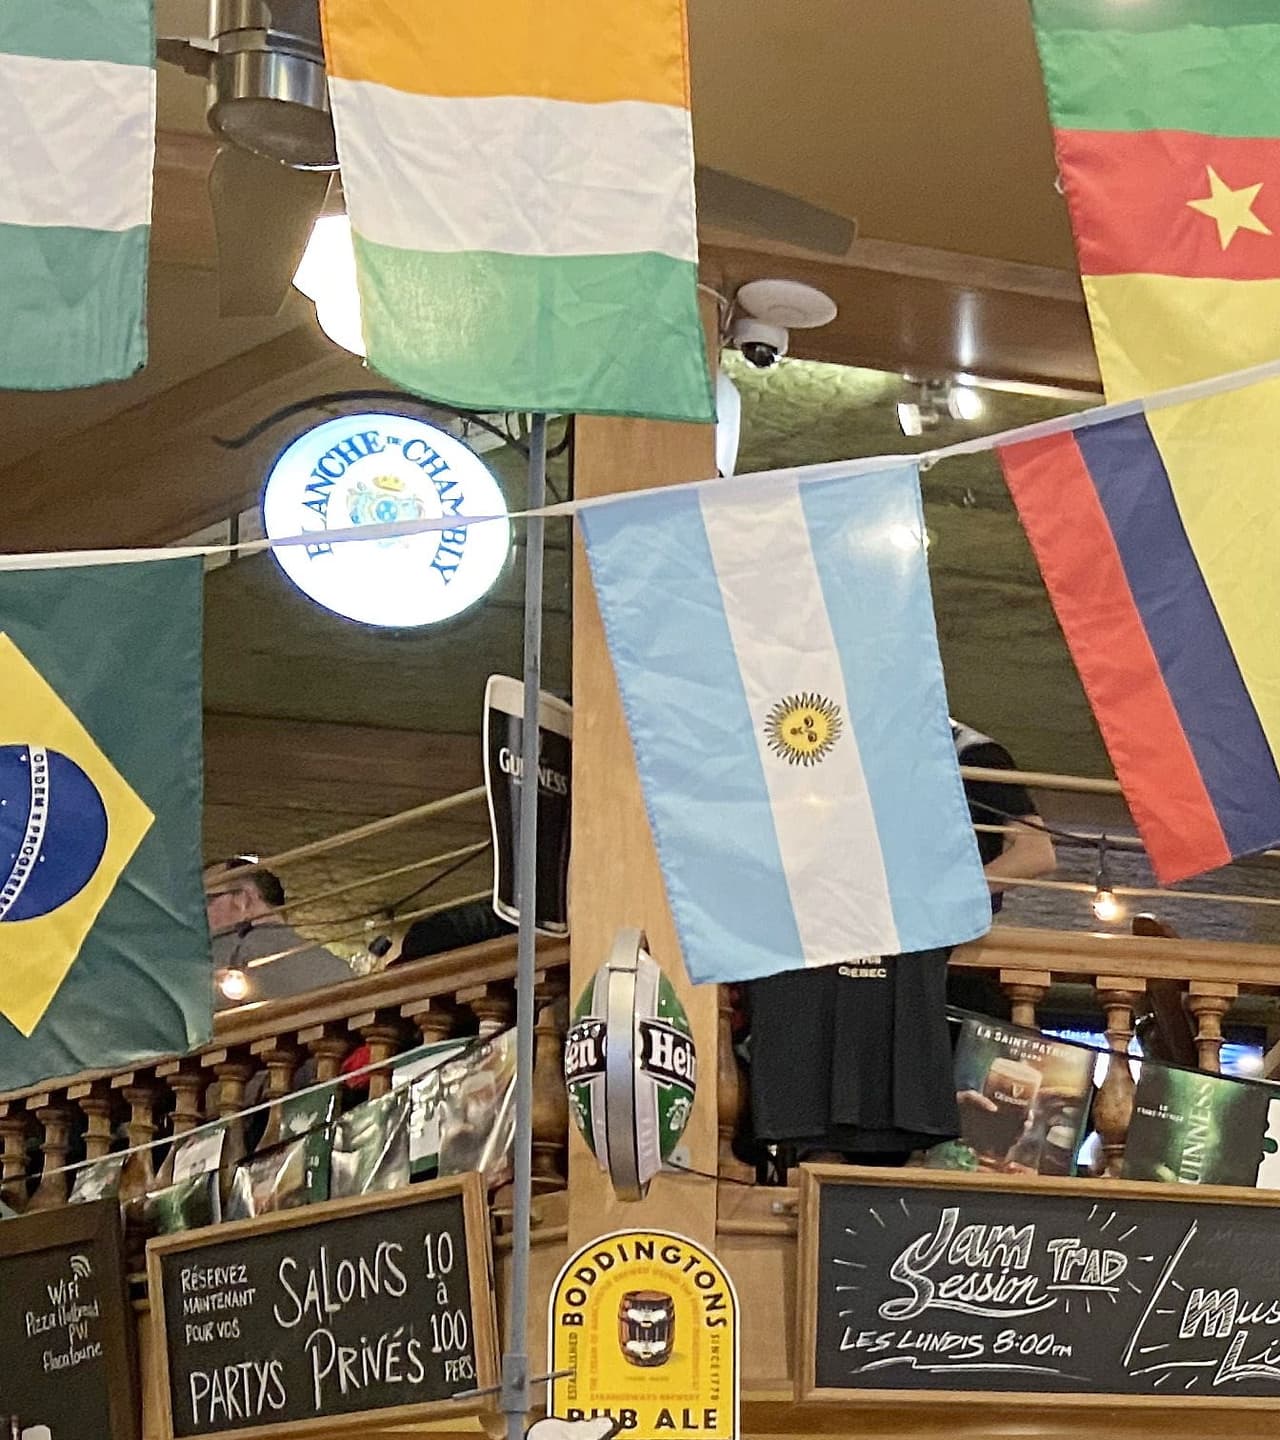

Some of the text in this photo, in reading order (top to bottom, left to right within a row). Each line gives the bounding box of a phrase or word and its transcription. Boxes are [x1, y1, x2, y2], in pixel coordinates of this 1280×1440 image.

[499, 747, 568, 796] GUNESS
[976, 1025, 992, 1040] LA
[423, 1230, 454, 1280] 10
[905, 1206, 1036, 1273] Jam
[182, 1288, 257, 1317] MAINTENANT
[272, 1240, 408, 1329] SALONS
[561, 1239, 728, 1329] BODDINGTONS
[878, 1235, 1050, 1321] Session
[185, 1316, 241, 1347] POUR VOS
[429, 1308, 469, 1355] 100
[839, 1326, 897, 1353] LES
[896, 1329, 985, 1359] LUNDIS
[189, 1359, 287, 1426] PARTYS
[654, 1408, 718, 1430] ALE
